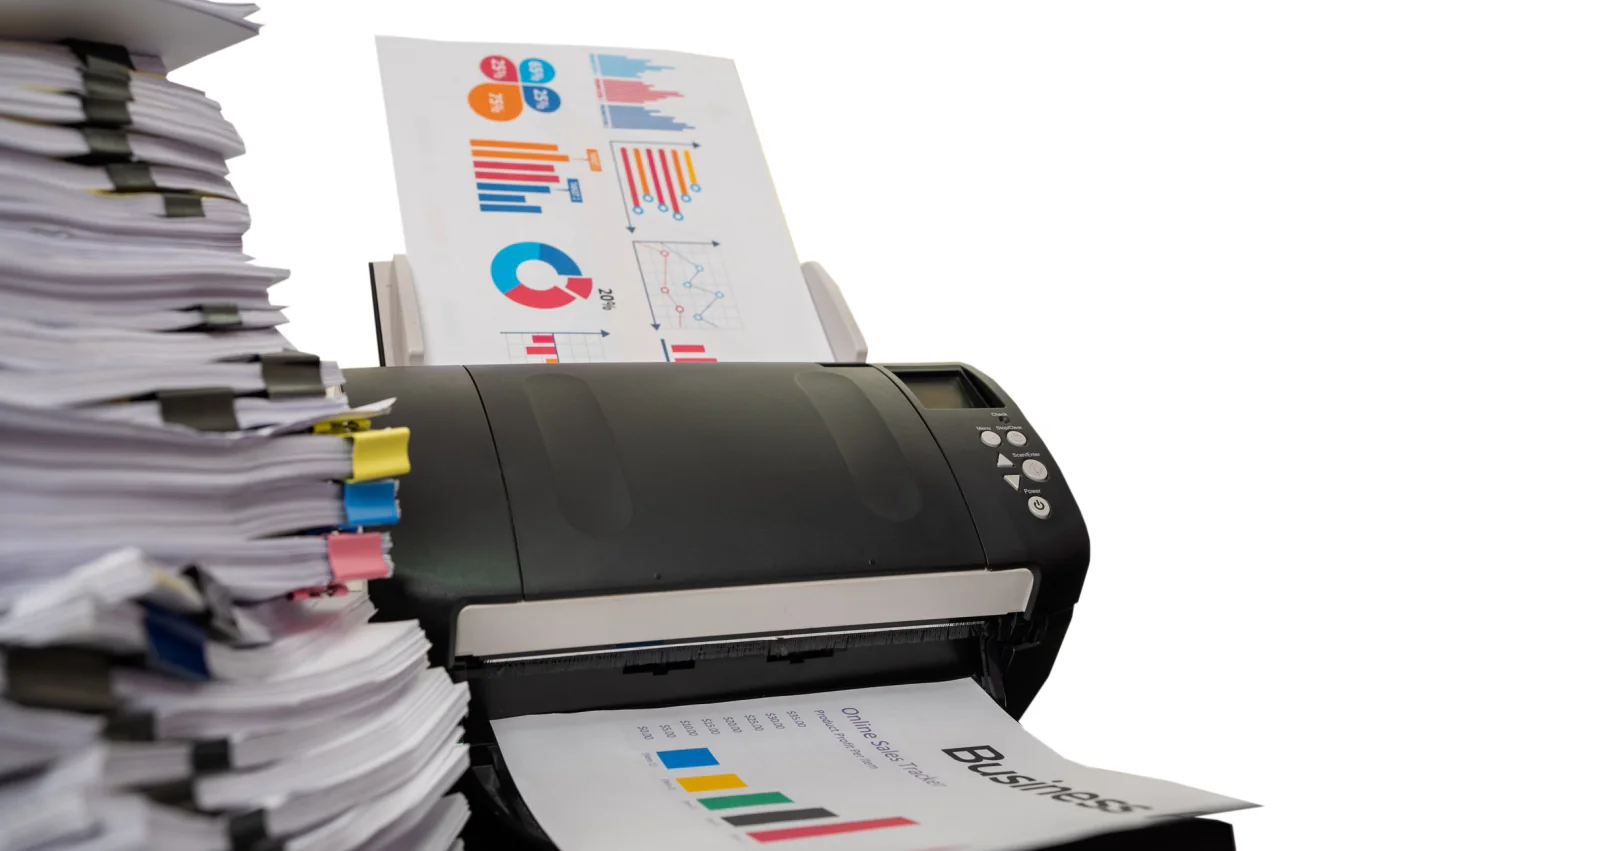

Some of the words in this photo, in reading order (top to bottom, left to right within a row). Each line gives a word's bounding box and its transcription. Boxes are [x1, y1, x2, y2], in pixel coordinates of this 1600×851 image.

[598, 288, 616, 310] 20%
[680, 720, 698, 736] $10.00
[701, 718, 720, 735] $15.00
[744, 714, 764, 731] $25.00
[765, 712, 785, 730] $30.00
[786, 710, 806, 728] $35.00
[659, 724, 676, 738] $5.00
[814, 709, 839, 733] Product
[834, 732, 854, 749] Profit
[849, 748, 864, 761] Per
[841, 707, 877, 739] Online
[870, 740, 904, 762] Sales
[898, 762, 948, 787] Tracker
[941, 745, 1153, 813] Business
